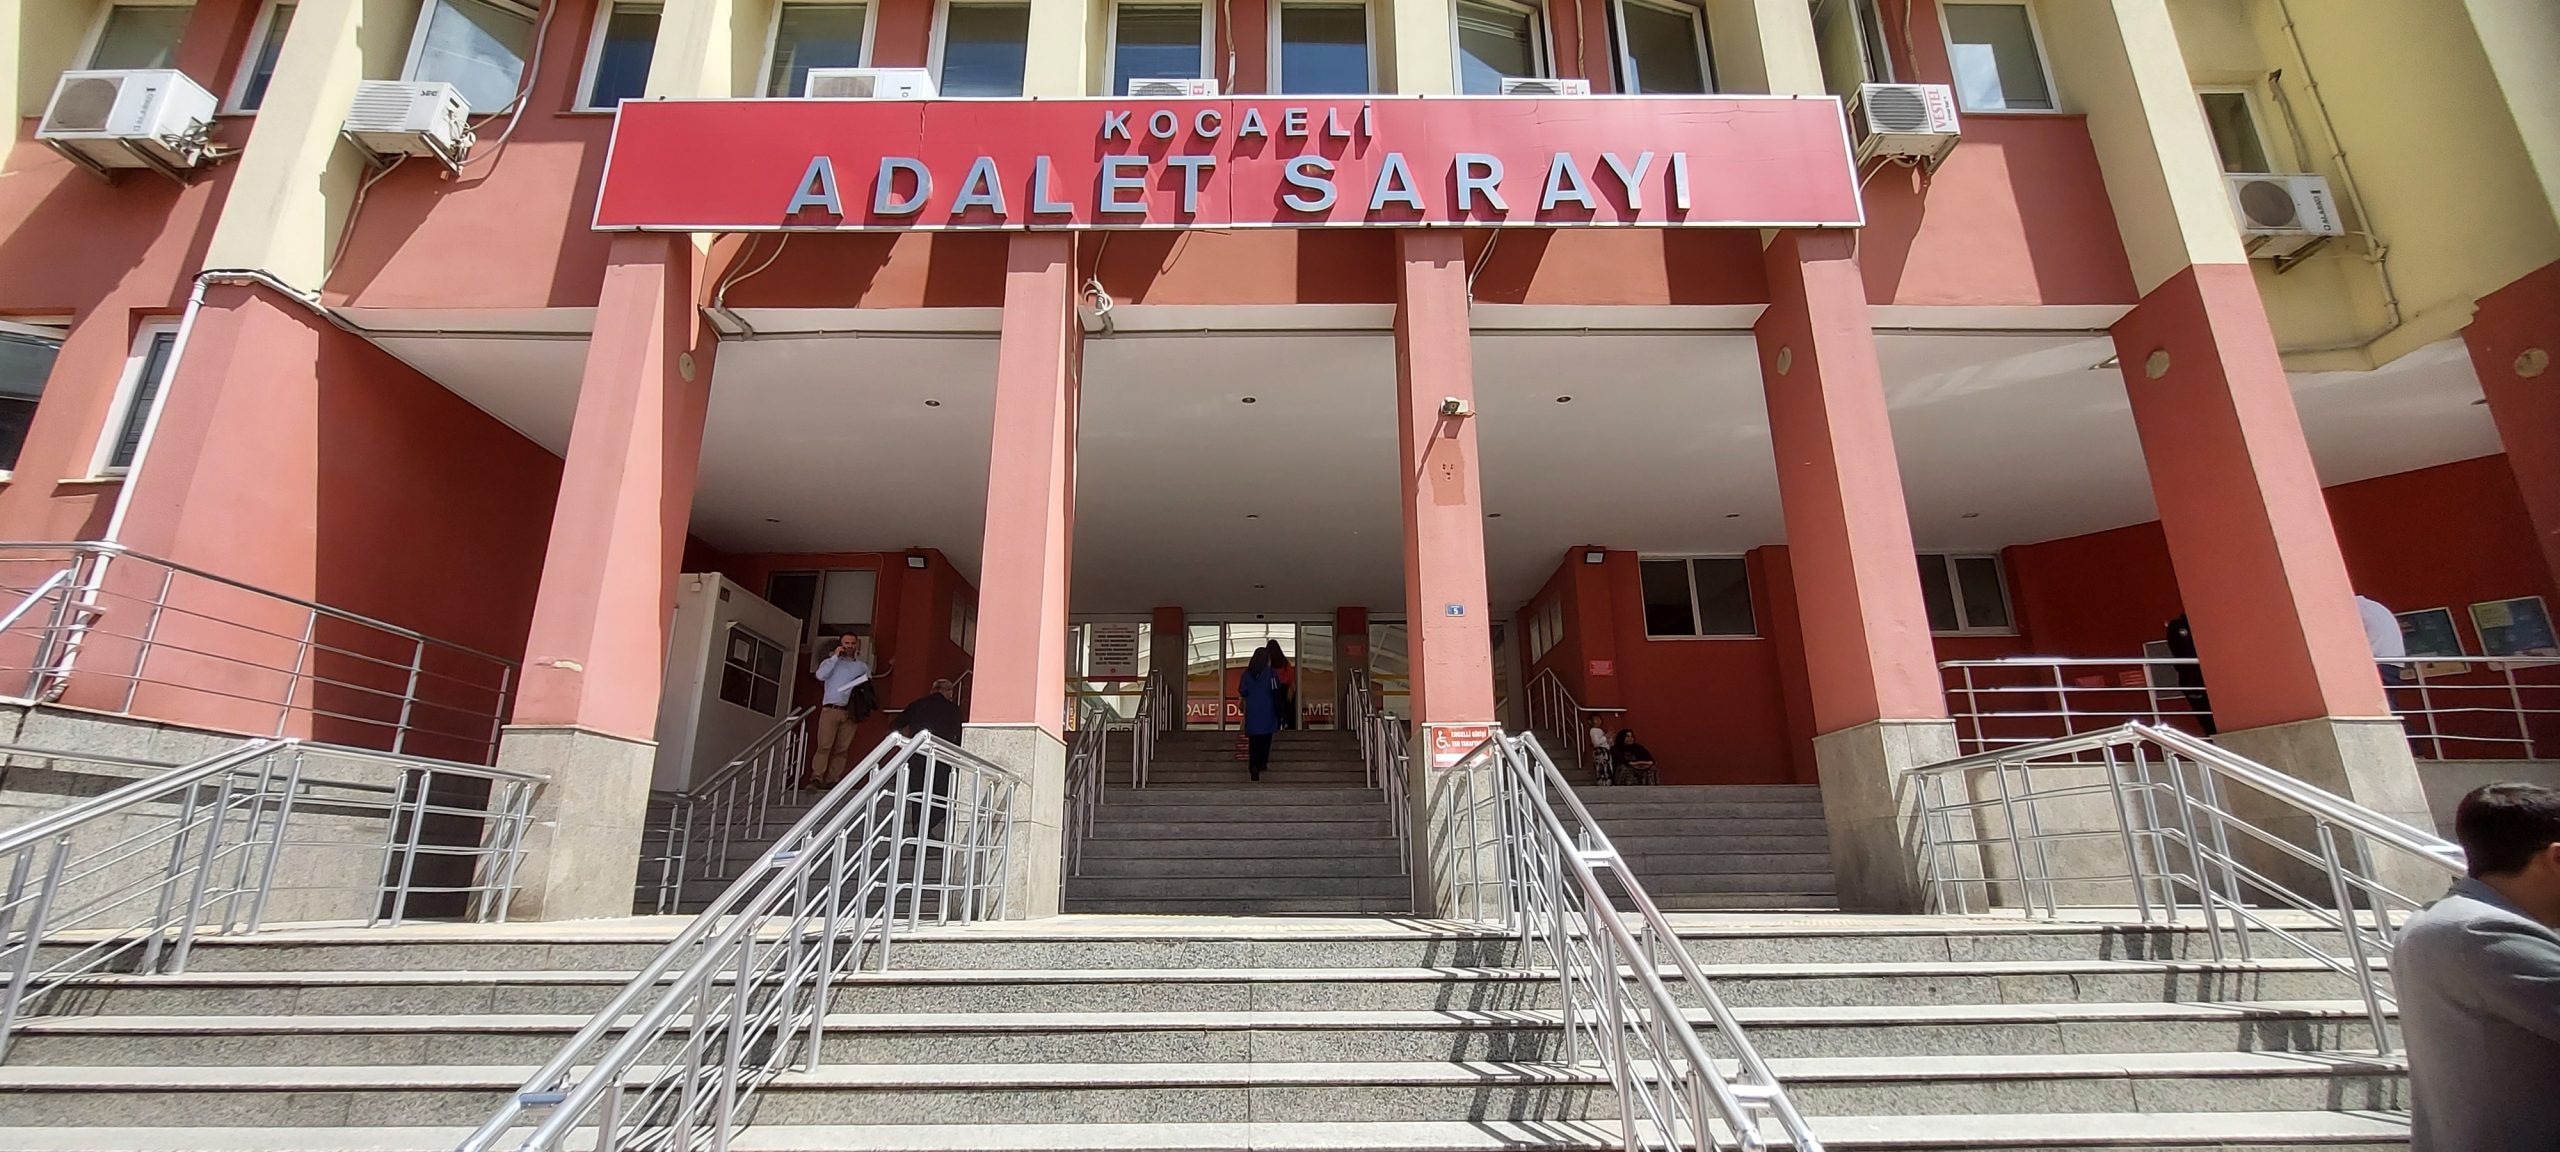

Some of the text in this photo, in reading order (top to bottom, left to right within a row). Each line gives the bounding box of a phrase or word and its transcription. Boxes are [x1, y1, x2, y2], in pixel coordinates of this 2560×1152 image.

[1103, 101, 1373, 140] KOCAELİ
[1927, 89, 1946, 128] VESTEL
[785, 151, 1690, 218] ADALET SARAYI
